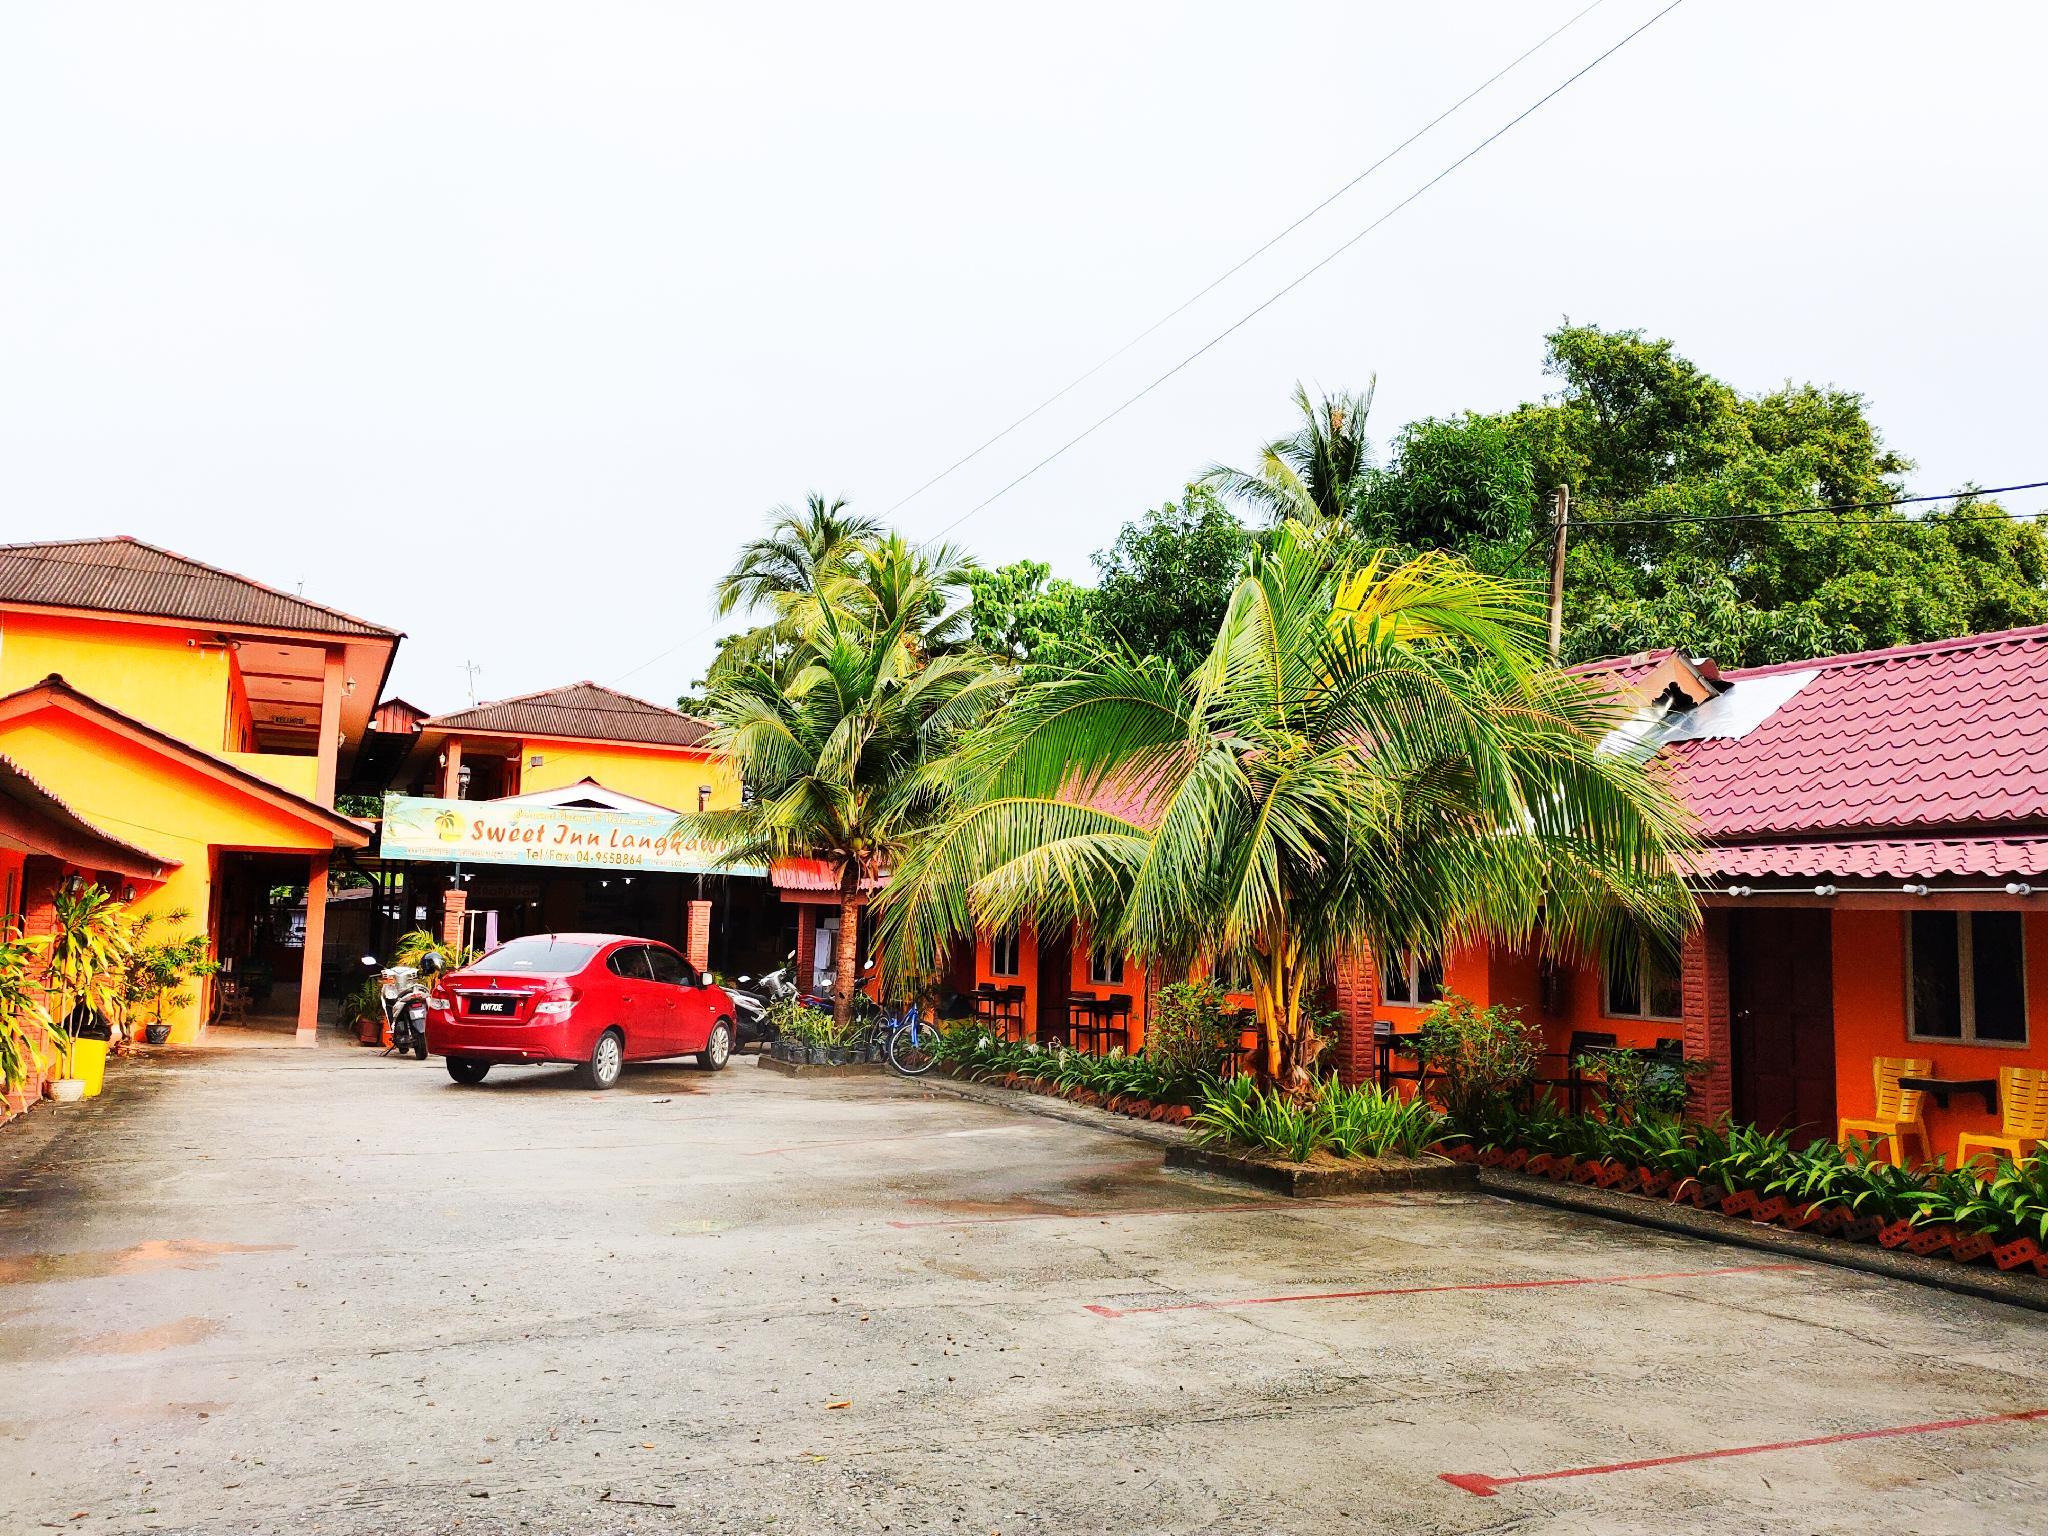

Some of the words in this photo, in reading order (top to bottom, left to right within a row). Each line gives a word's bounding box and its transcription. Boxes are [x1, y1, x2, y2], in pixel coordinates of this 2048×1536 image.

[471, 819, 546, 844] Sweet
[553, 824, 600, 846] Inn
[576, 850, 643, 865] 04-9558864
